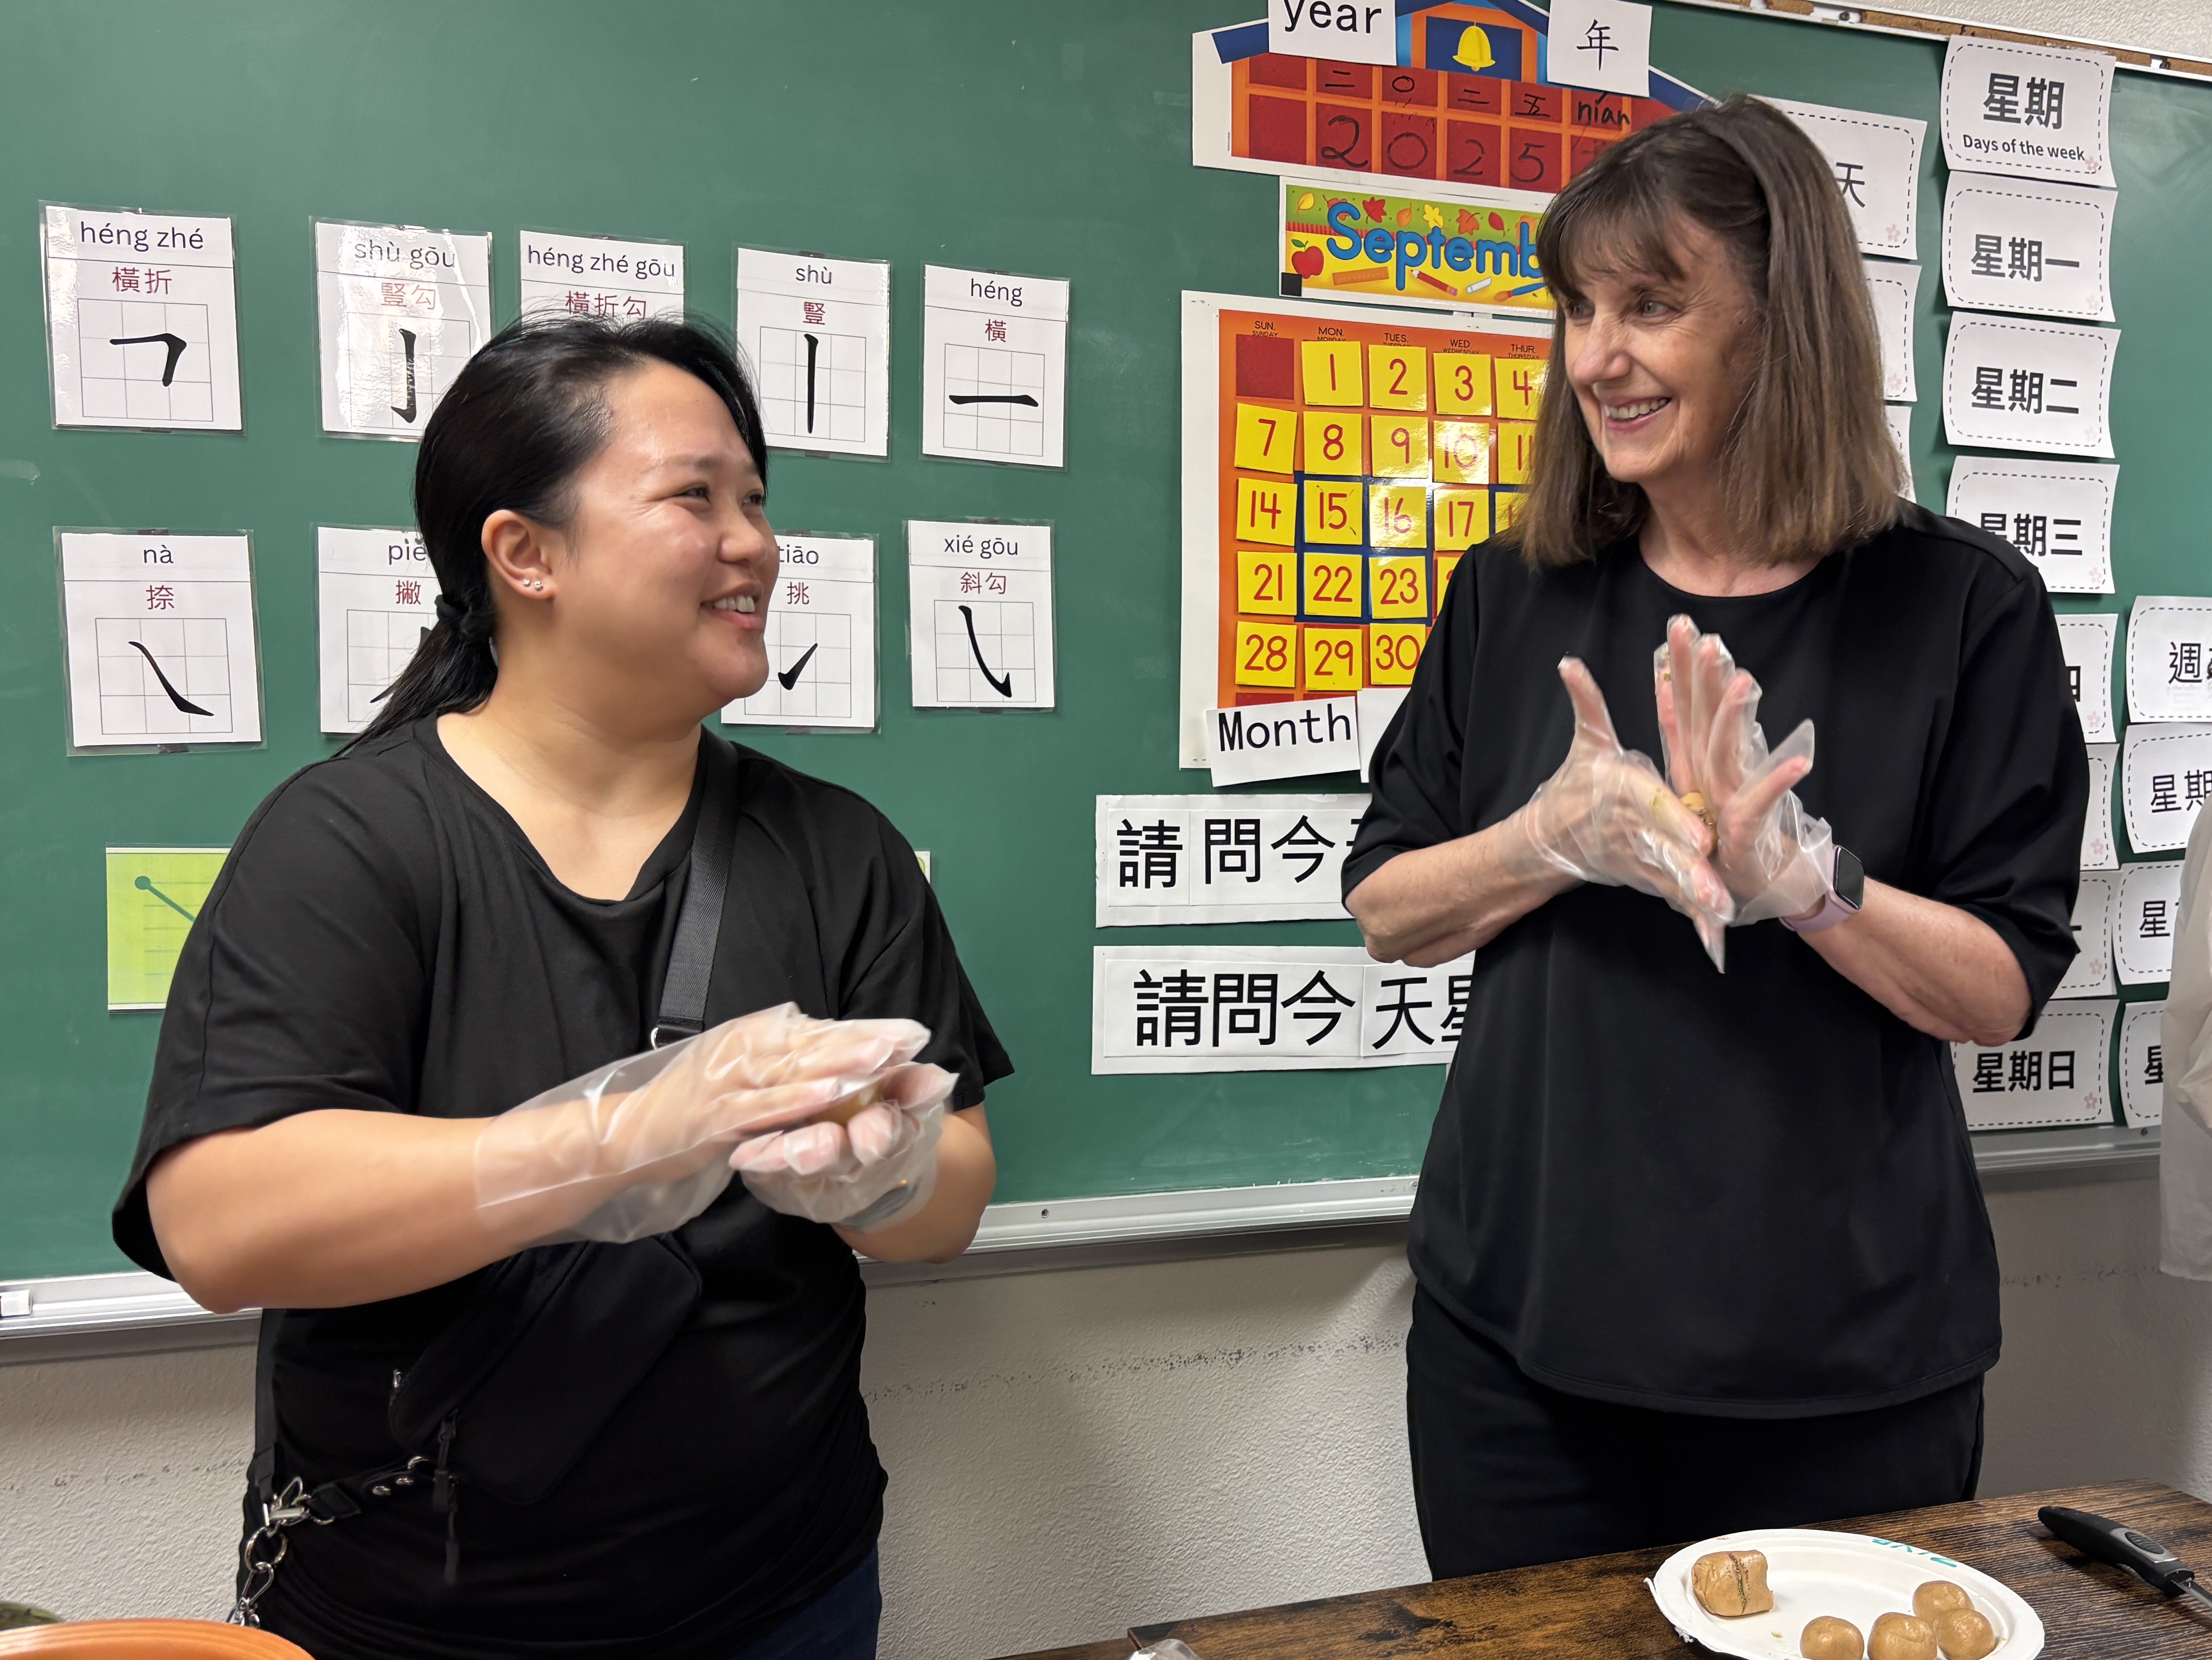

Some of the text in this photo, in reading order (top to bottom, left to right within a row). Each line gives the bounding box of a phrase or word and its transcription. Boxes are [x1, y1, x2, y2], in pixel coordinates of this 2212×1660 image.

[1284, 0, 1381, 33] year
[1576, 19, 1619, 70] 年
[1984, 73, 2065, 129] 星期
[1963, 134, 2085, 161] Days of the week
[1836, 162, 1865, 207] 天
[81, 221, 203, 252] héng zhé
[355, 239, 454, 270] shù gōu
[529, 245, 674, 279] héng zhé gōu
[1971, 234, 2079, 281] 星期一
[112, 266, 172, 295] 橫折
[796, 265, 831, 284] shù
[381, 282, 436, 310] 豎勾
[565, 291, 646, 319] 橫折勾
[970, 278, 1023, 307] héng
[803, 302, 825, 325] 豎
[985, 319, 1006, 342] 橫
[1254, 321, 1275, 330] SUN.
[1318, 326, 1345, 337] MON.
[1384, 333, 1409, 343] TUES.
[1330, 354, 1533, 406] 1 2 3 4
[1972, 367, 2079, 414] 星期二
[1258, 419, 1533, 471] 7 8 9 10 11
[1251, 491, 1282, 529] 14
[1320, 492, 1347, 529] 15
[1384, 498, 1411, 533] 16
[1449, 501, 1474, 537] 17
[144, 545, 174, 563] nà
[944, 535, 1018, 559] xié gōu
[146, 585, 174, 610] 捺
[396, 580, 421, 604] 撇
[787, 582, 809, 604] 挑
[961, 572, 1006, 594] 斜勾
[1254, 564, 1418, 604] 21 22 23
[1244, 635, 1420, 676] 28 29 30
[2168, 642, 2212, 684] 週
[1218, 703, 1351, 752] Month
[1117, 815, 1363, 889] 請問今
[1973, 1050, 2075, 1093] 星期日
